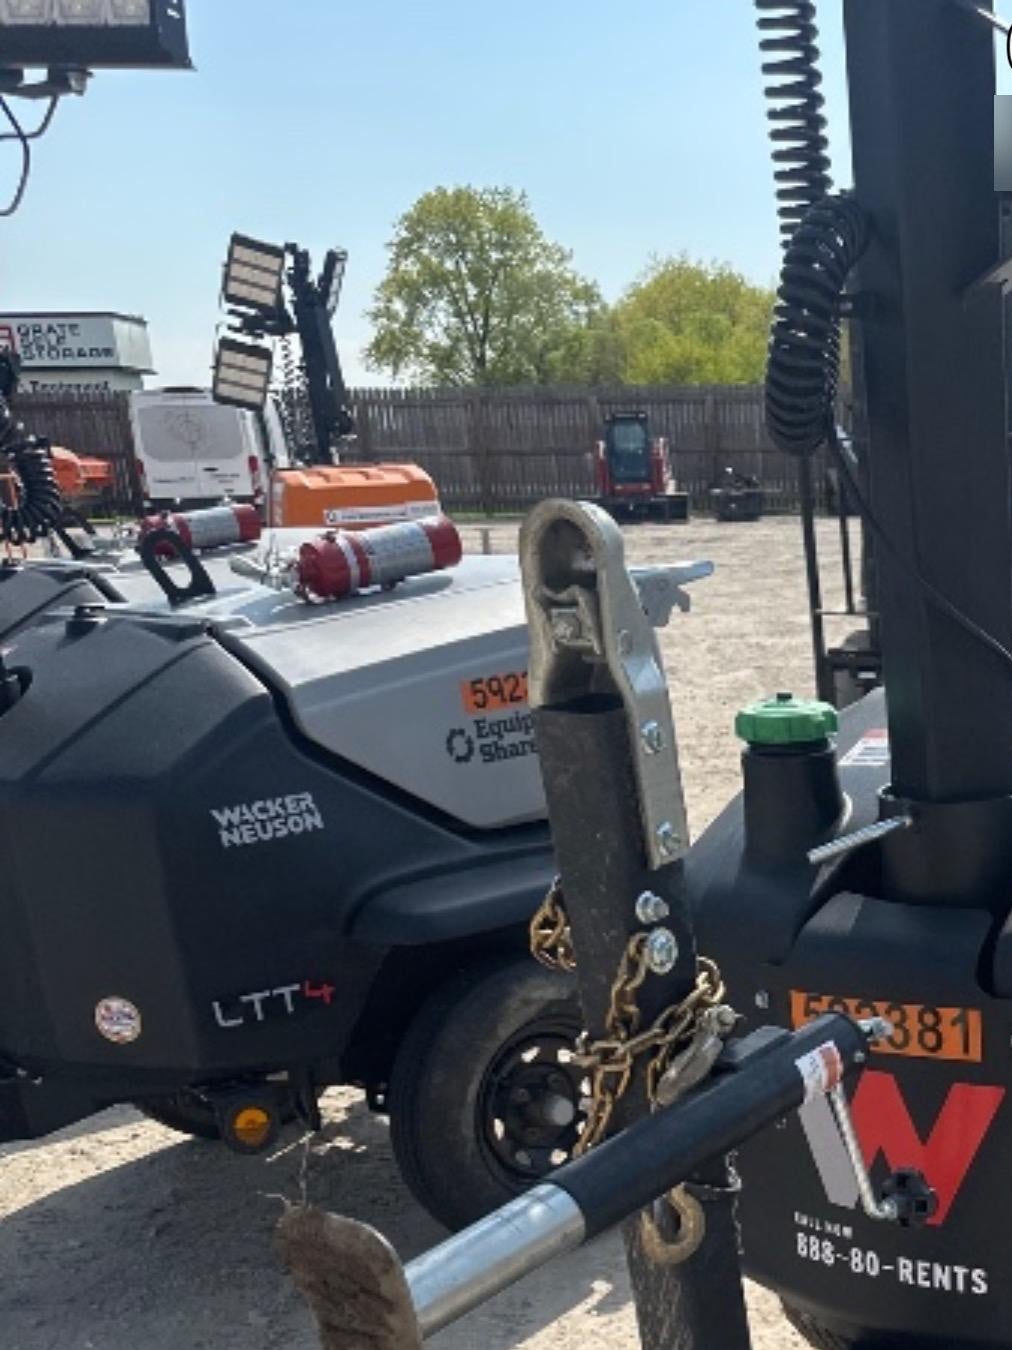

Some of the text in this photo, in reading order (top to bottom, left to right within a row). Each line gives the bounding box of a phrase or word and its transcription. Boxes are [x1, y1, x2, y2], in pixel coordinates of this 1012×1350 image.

[210, 791, 315, 829] WACKER
[218, 811, 325, 849] NEUSON
[211, 980, 336, 1028] LTT4
[796, 1231, 990, 1295] 888-80-RENTS
